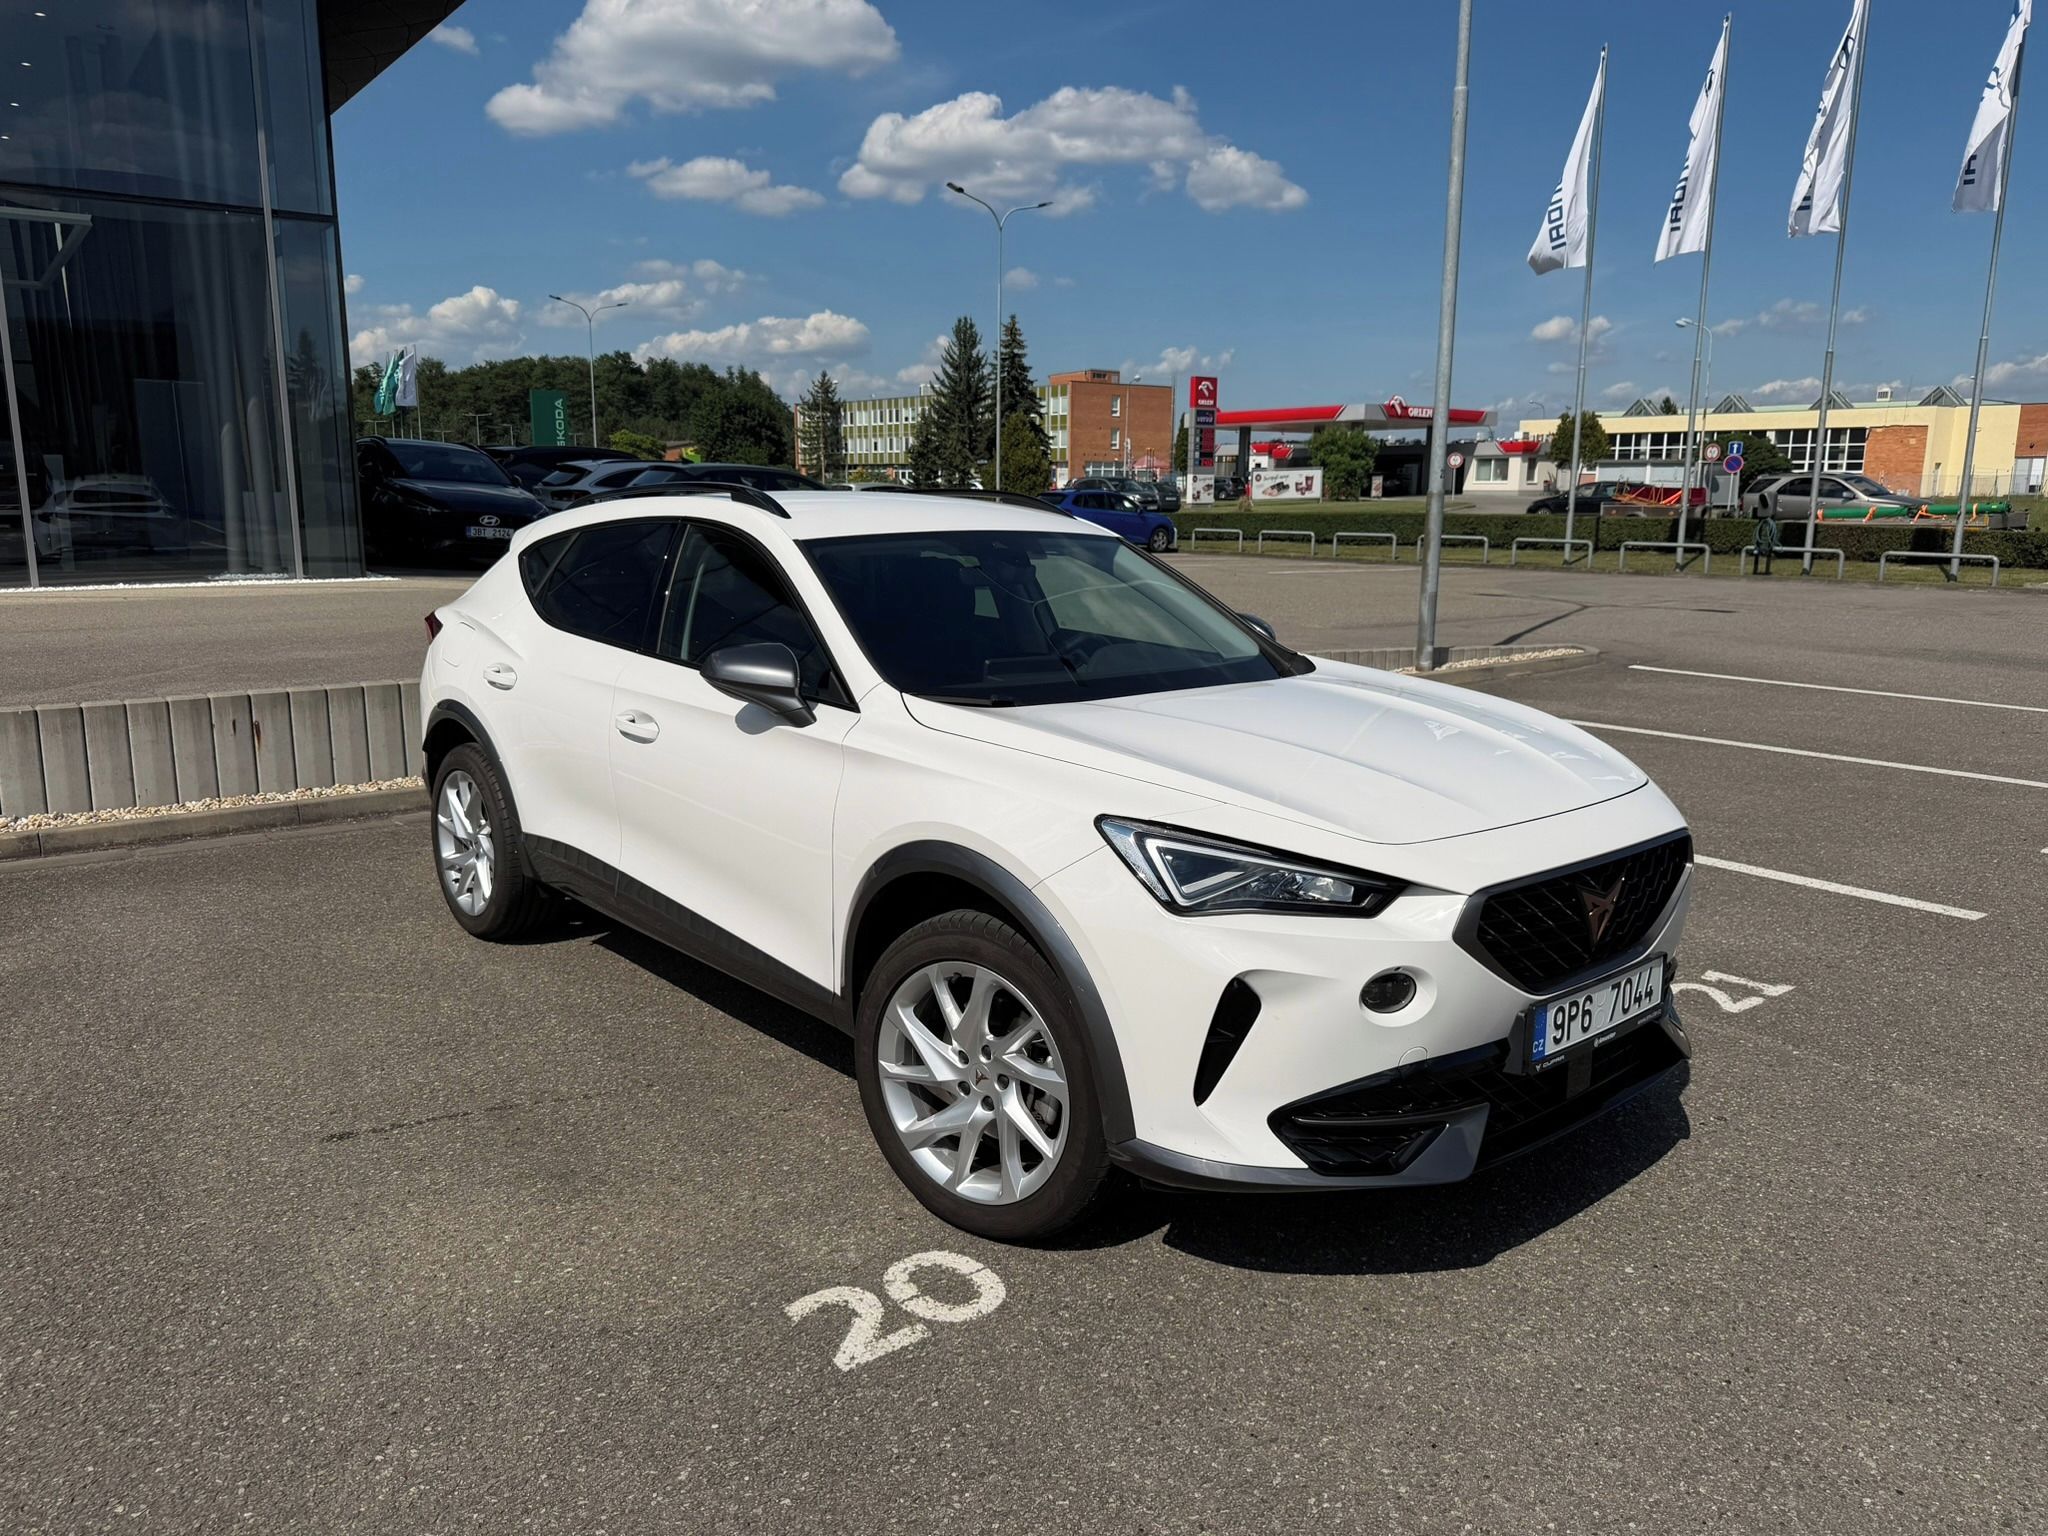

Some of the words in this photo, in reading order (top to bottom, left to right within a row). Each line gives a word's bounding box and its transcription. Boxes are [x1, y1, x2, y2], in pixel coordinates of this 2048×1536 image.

[1408, 407, 1433, 418] ORLEN
[1552, 994, 1593, 1045] 9P6
[1608, 967, 1654, 1023] 7044
[1532, 1039, 1544, 1053] CZ
[783, 1250, 1007, 1372] 20
